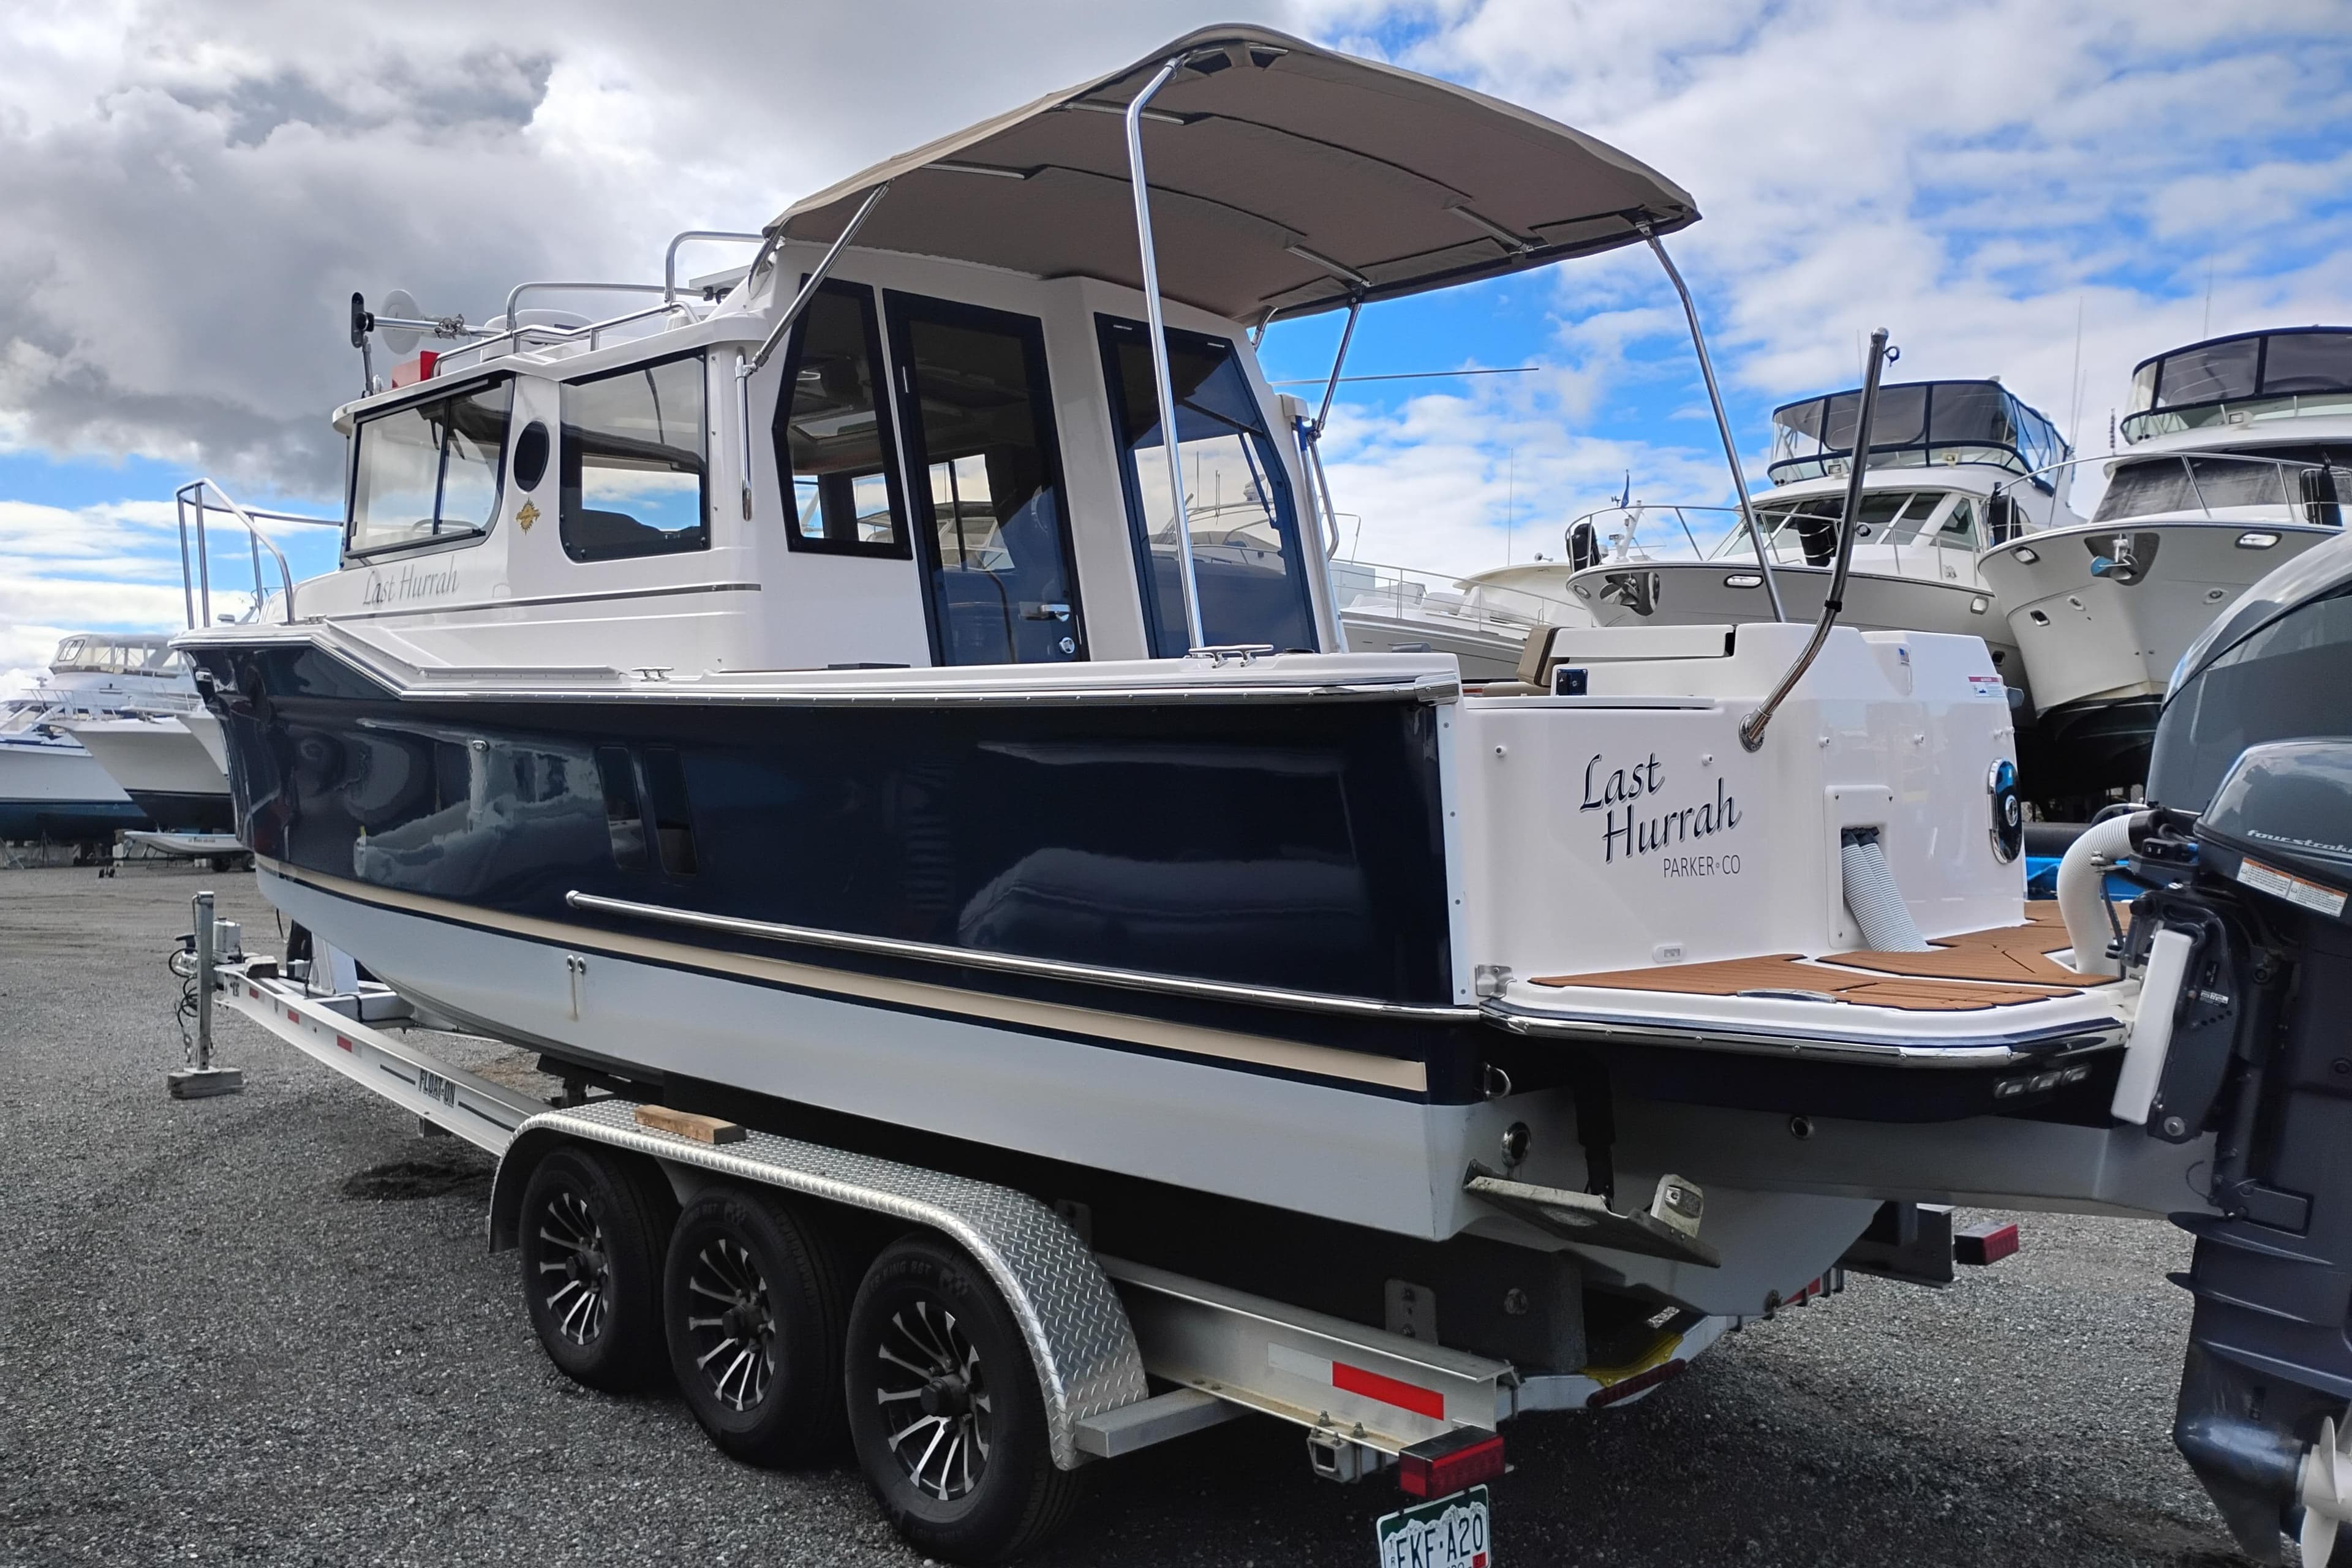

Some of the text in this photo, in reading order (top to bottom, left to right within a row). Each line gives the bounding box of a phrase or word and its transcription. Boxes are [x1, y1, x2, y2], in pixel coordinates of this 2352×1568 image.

[363, 554, 460, 605] Last Hurrah
[1579, 752, 1665, 812] Last
[1602, 777, 1742, 864] Hurrah
[418, 1068, 456, 1108] FLOAT-ON
